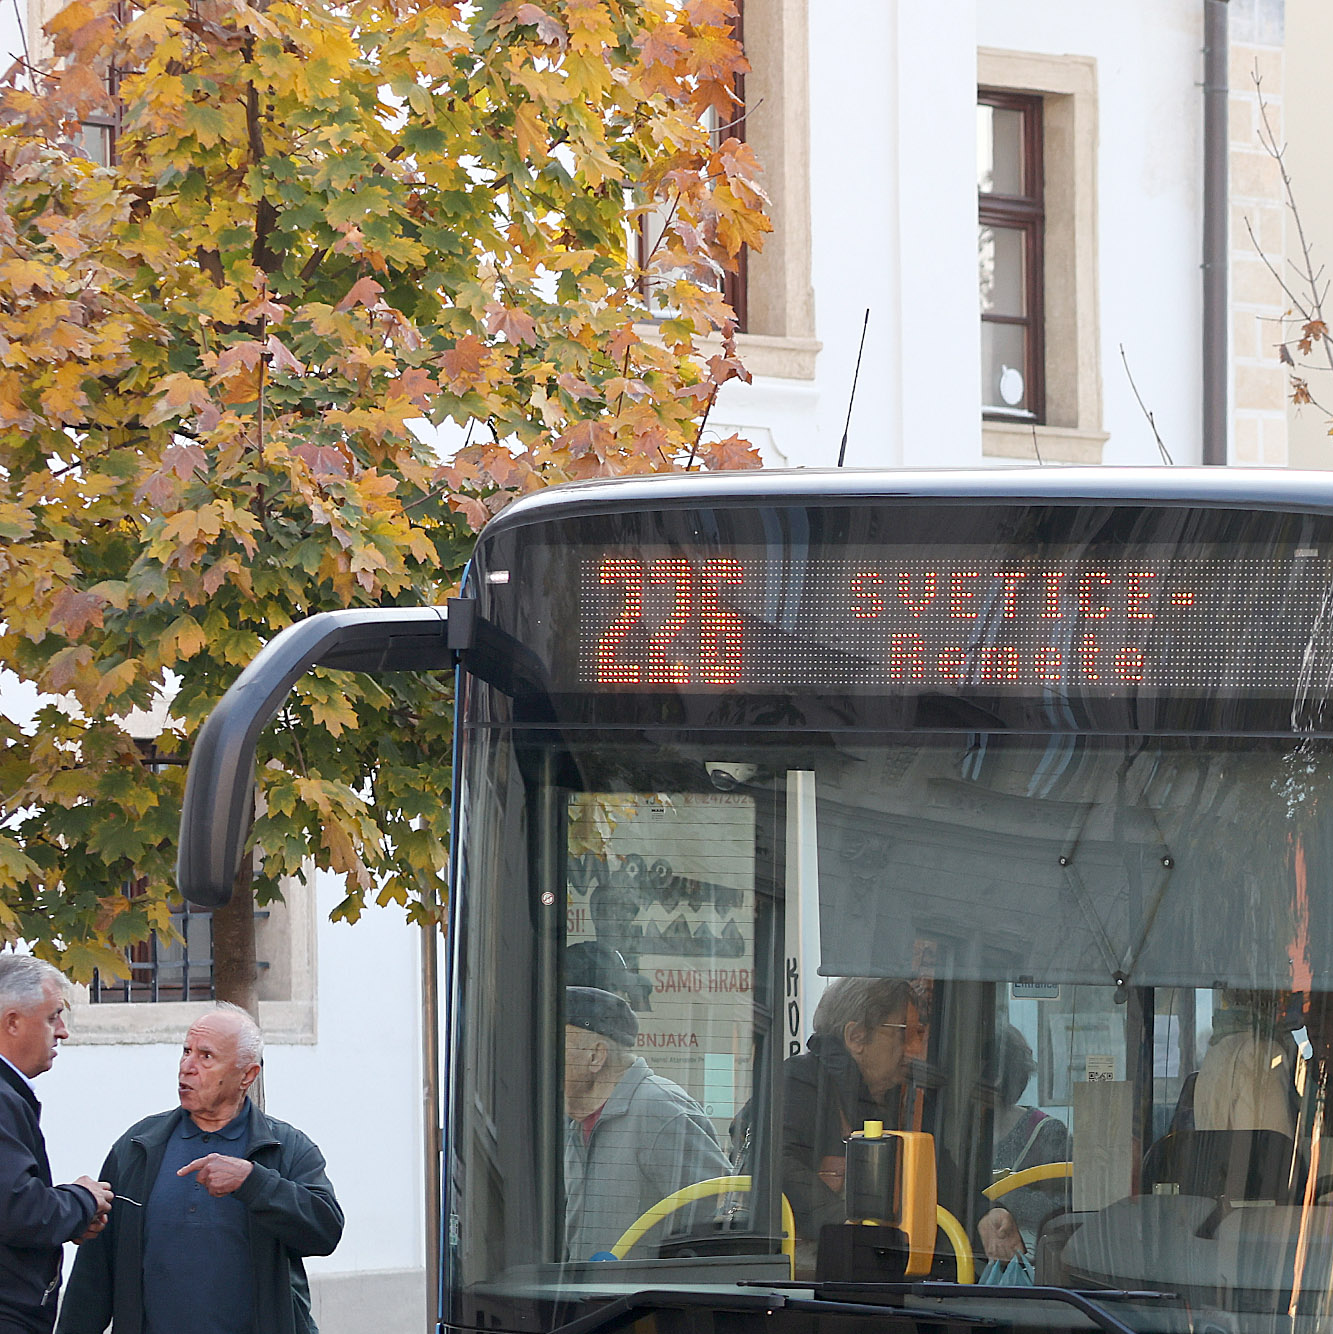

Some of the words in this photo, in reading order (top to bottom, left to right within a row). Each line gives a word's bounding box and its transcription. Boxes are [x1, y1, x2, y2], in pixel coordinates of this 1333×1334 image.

[598, 558, 743, 684] 226
[890, 632, 1143, 680] Remete
[708, 967, 755, 994] HRAB
